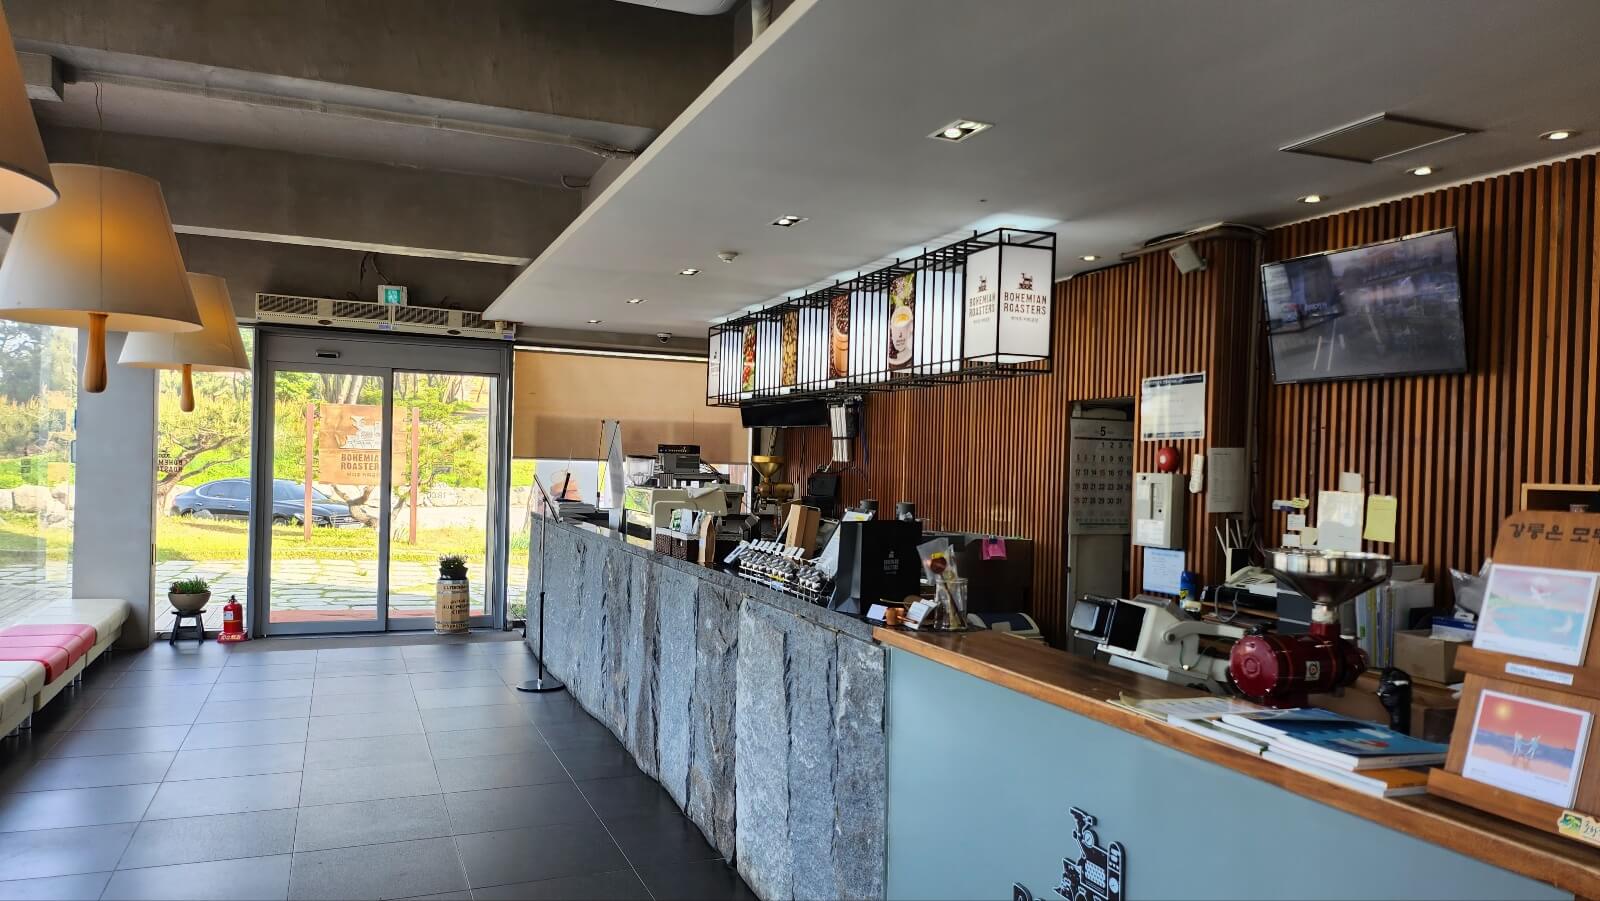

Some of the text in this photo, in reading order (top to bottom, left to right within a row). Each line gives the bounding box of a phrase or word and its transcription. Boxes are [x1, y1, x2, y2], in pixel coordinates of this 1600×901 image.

[970, 293, 996, 306] BOHEMIAN
[1004, 291, 1047, 304] BOHEMIAN
[969, 304, 995, 317] ROASTERS
[1003, 302, 1046, 316] ROASTERS
[1100, 426, 1106, 436] 5
[341, 453, 379, 462] BOHEMIA
[340, 462, 379, 470] ROASTER
[1510, 523, 1564, 541] 강릉은
